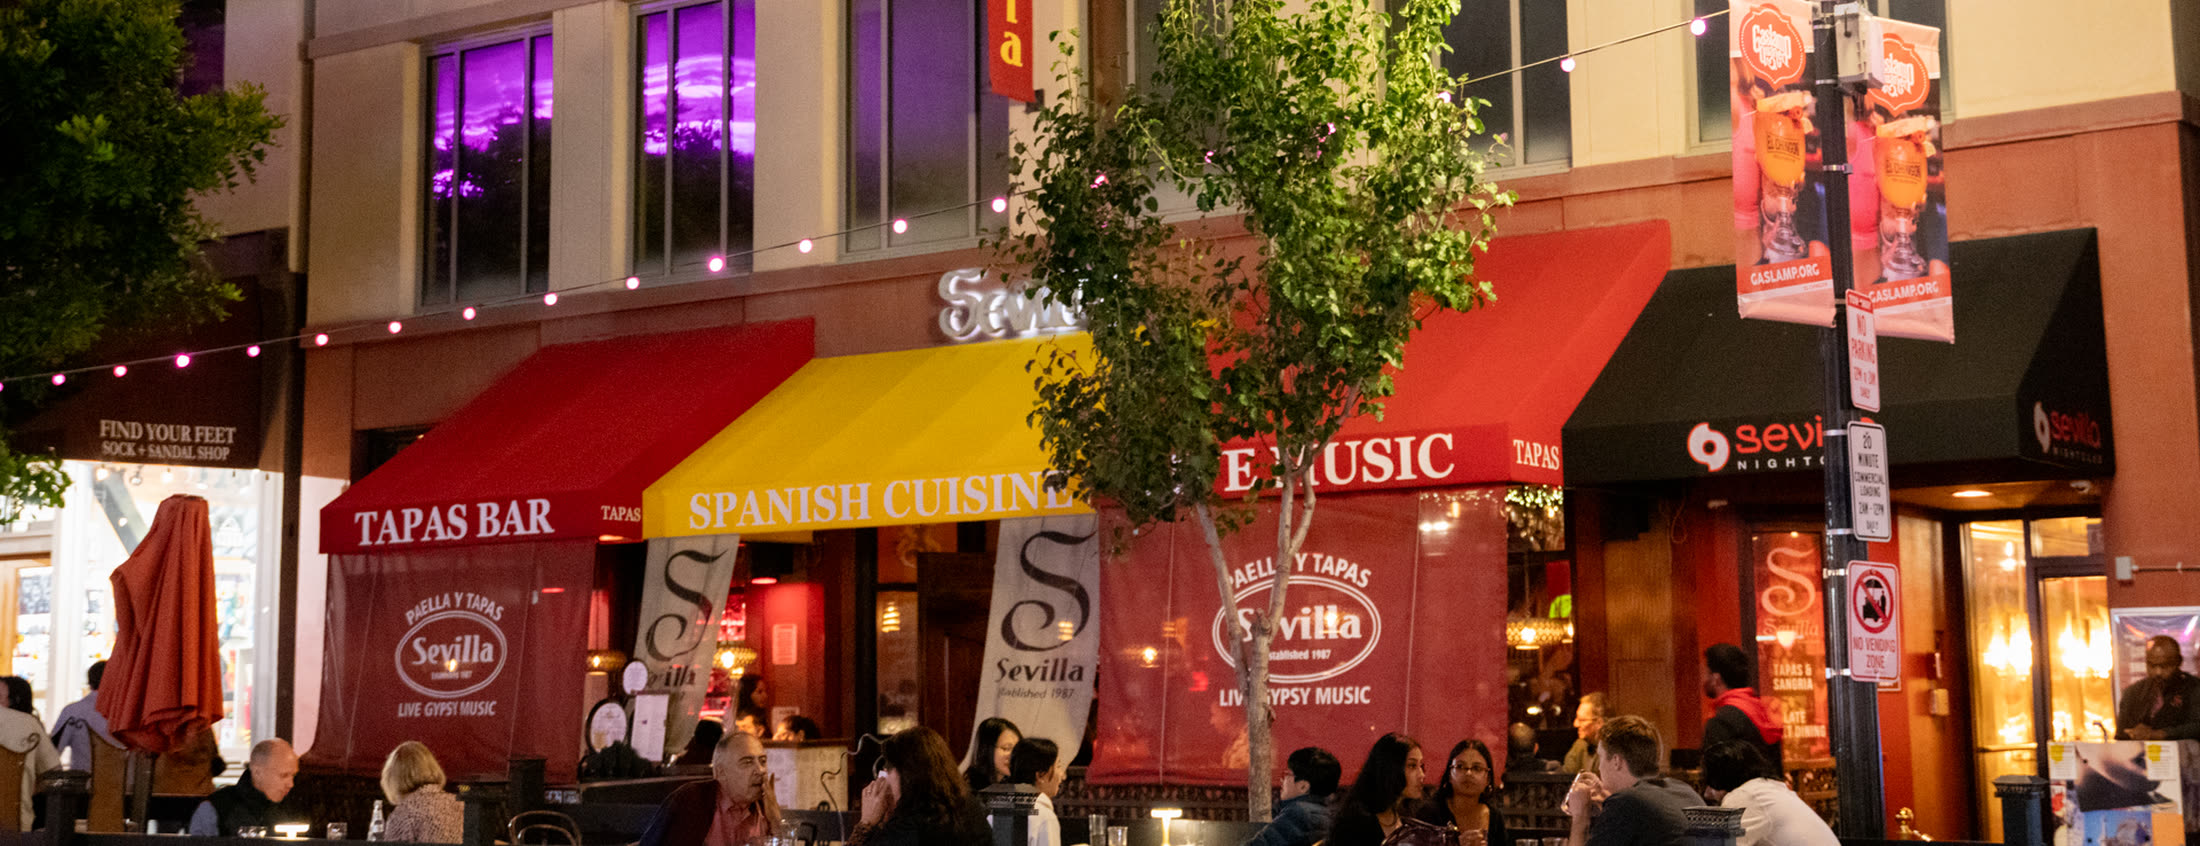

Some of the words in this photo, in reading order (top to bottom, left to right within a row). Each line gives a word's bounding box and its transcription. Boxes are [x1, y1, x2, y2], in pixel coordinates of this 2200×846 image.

[1750, 263, 1820, 286] GASLAMP.ORG
[1869, 281, 1939, 304] GASLAMP.ORG
[1856, 313, 1867, 337] NO
[1851, 337, 1875, 364] PARKING
[100, 420, 143, 440] FIND
[146, 423, 191, 442] YOUR
[194, 425, 236, 444] FEET
[1735, 414, 1824, 454] sevi
[1863, 434, 1873, 450] 20
[102, 440, 138, 457] SOCK
[147, 442, 197, 459] SANDAL
[198, 445, 230, 460] SHOP
[1512, 438, 1560, 471] TAPAS
[1858, 452, 1879, 469] MINUTE
[1737, 455, 1825, 470] NIGHT
[1854, 471, 1885, 486] COMMERCIAL
[689, 483, 872, 530] SPANISH
[883, 469, 1073, 518] CUISINE
[1859, 485, 1881, 498] LOADING
[354, 502, 468, 546] TAPAS
[476, 498, 555, 538] BAR
[600, 504, 641, 523] TAPAS
[1295, 553, 1308, 572] Y
[1313, 553, 1372, 588] TAPAS
[405, 593, 451, 626] PAELLA
[454, 591, 463, 608] Y
[466, 592, 505, 621] TAPAS
[1238, 605, 1362, 642] Svilla
[411, 634, 494, 665] Sevilla
[1268, 649, 1309, 661] stablished
[1311, 649, 1332, 660] 1987
[1853, 636, 1863, 650] NO
[1865, 638, 1896, 653] VENDING
[995, 657, 1084, 687] Sevilla
[1773, 663, 1803, 676] TAPAS
[1866, 654, 1885, 669] ZONE
[1050, 687, 1076, 700] 1987
[1773, 677, 1814, 691] SANGRIA
[1219, 688, 1242, 706] LIV
[1315, 685, 1372, 705] MUSIC
[398, 702, 423, 718] LIVE
[424, 701, 459, 717] GYPSY
[460, 700, 497, 717] MUSIC
